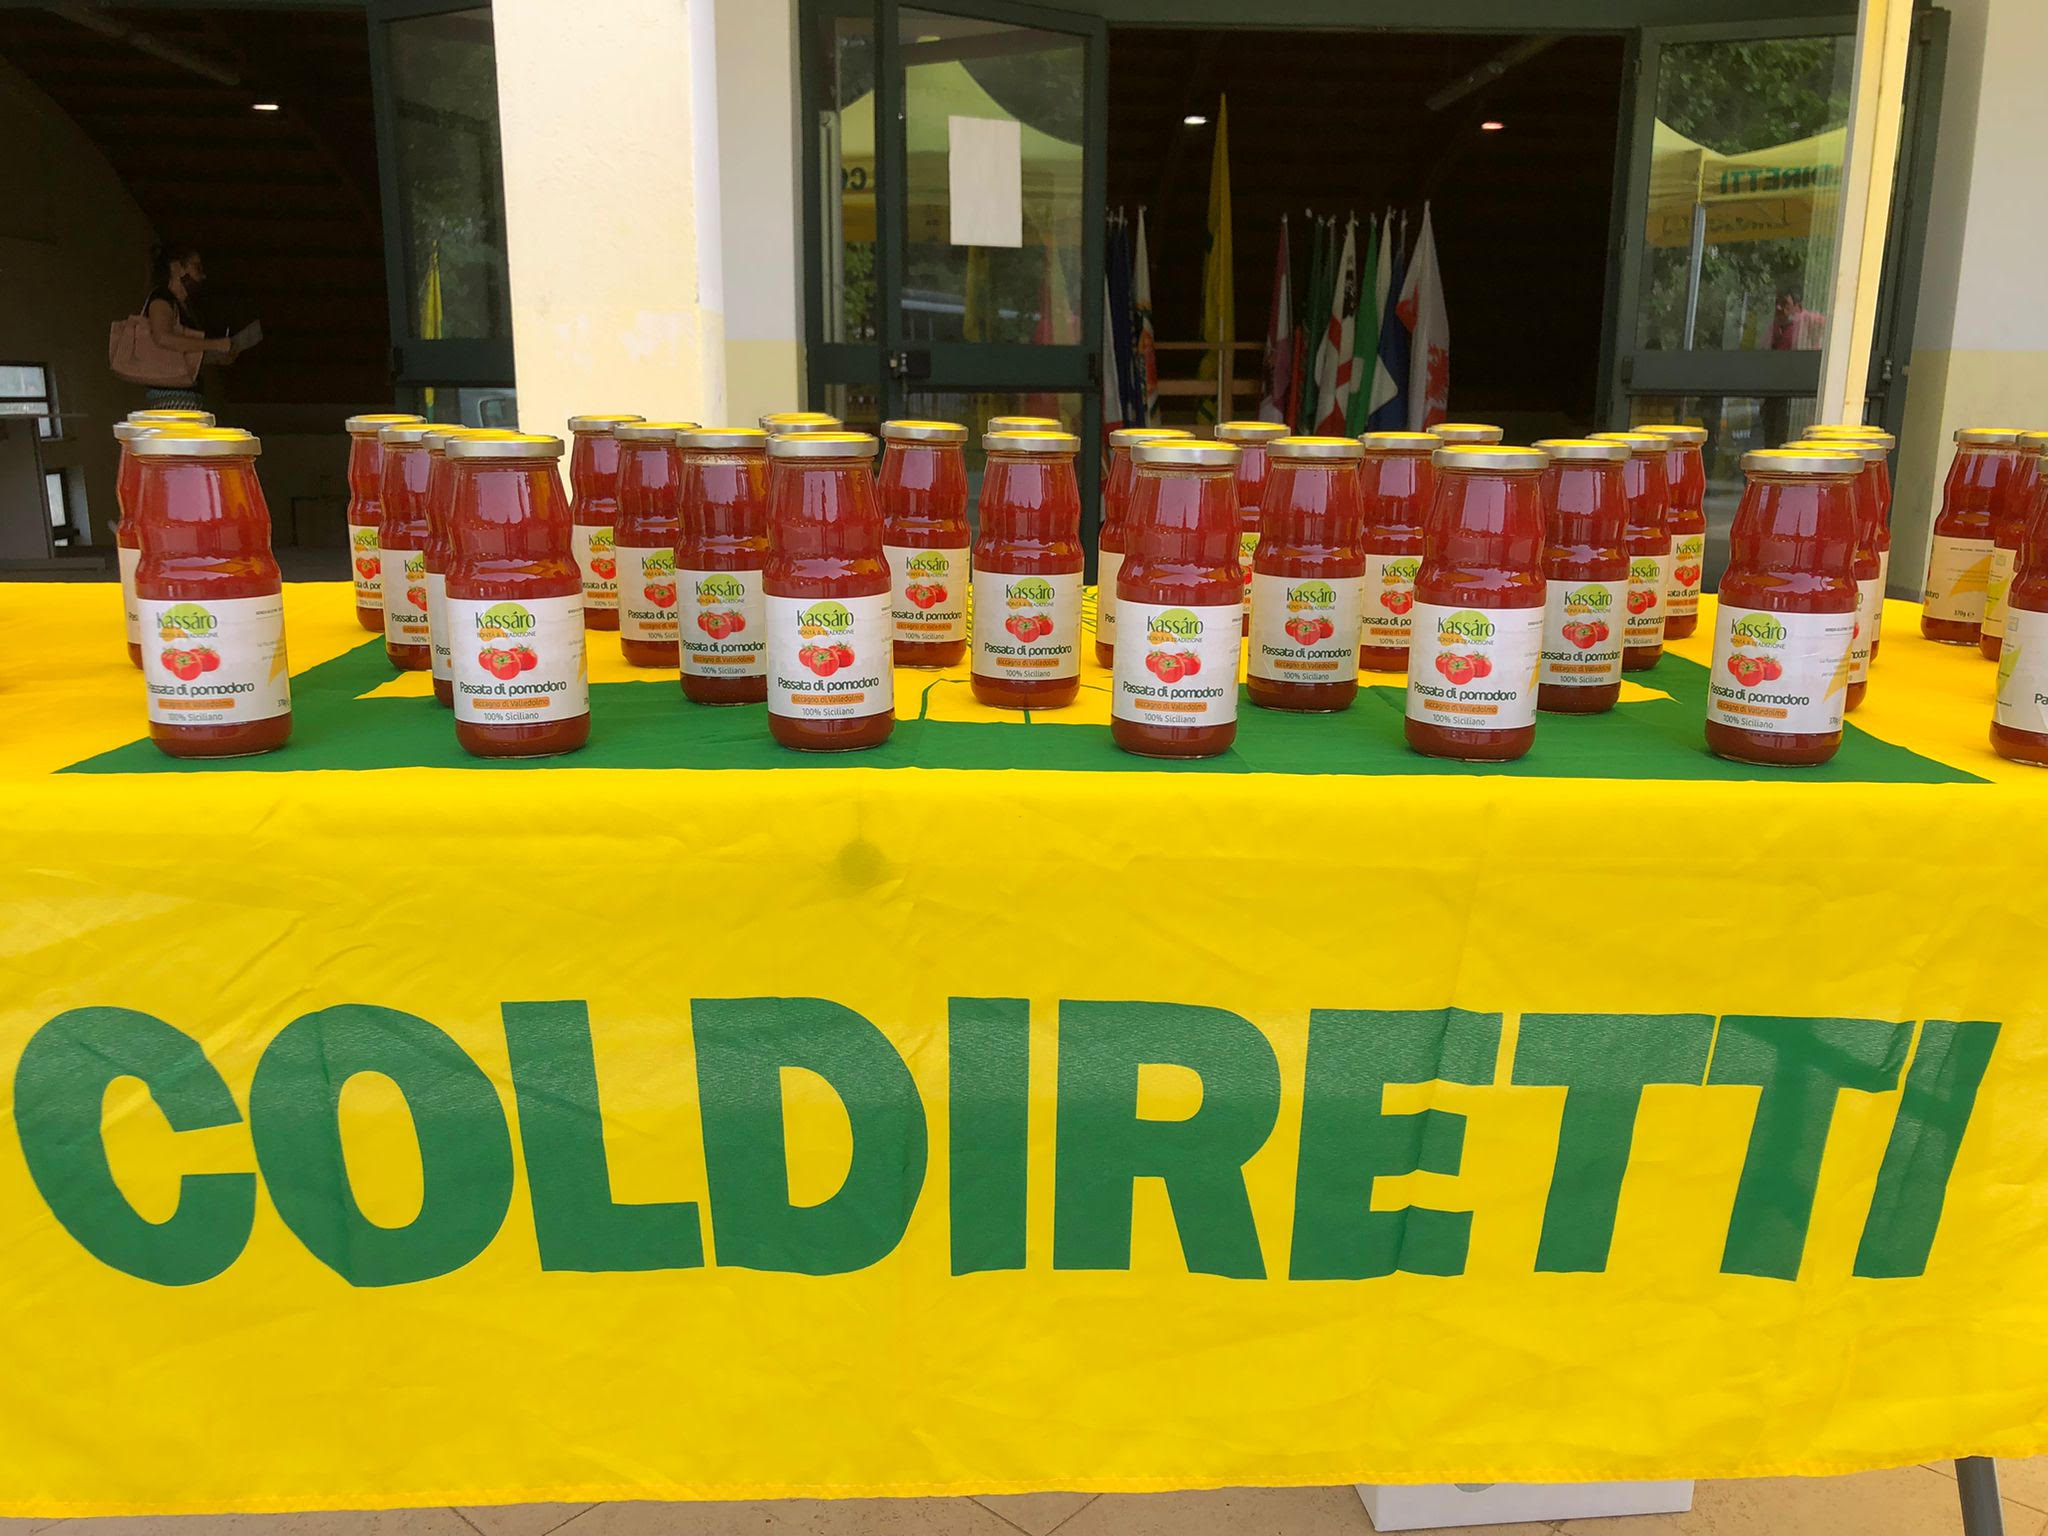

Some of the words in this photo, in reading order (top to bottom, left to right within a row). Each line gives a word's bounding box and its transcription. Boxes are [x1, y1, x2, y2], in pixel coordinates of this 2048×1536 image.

[353, 534, 378, 545] Kassár
[588, 534, 615, 545] Kass
[641, 556, 675, 570] Kassá
[906, 556, 950, 571] Kassáro
[1381, 564, 1418, 577] Kassár
[1631, 564, 1660, 577] assáro
[695, 581, 745, 597] Kassáro
[1005, 584, 1055, 600] Kassáro
[1286, 587, 1337, 603] Kassáro
[1564, 591, 1613, 606] Kassáro
[156, 611, 218, 630] Kassáro
[391, 613, 418, 623] Passata
[475, 611, 536, 629] Kassáro
[628, 609, 655, 619] Passata
[656, 610, 665, 620] di
[796, 609, 854, 627] Kassáro
[891, 611, 914, 619] ssata
[915, 611, 924, 620] di
[925, 611, 962, 621] pomodoro
[1362, 616, 1389, 625] assata
[1390, 616, 1399, 626] di
[1627, 616, 1636, 626] di
[1147, 615, 1203, 635] Kassáro
[1437, 616, 1495, 637] Kassáro
[1730, 618, 1787, 641] Kassáro
[436, 644, 450, 655] Pass
[683, 640, 708, 651] Passata
[709, 642, 719, 652] di
[721, 641, 766, 653] pomodor
[984, 642, 1015, 655] Passata
[1016, 645, 1026, 656] di
[1029, 645, 1072, 657] pomodoro
[1262, 644, 1294, 657] Passata
[1295, 648, 1305, 658] di
[1307, 648, 1352, 660] pomodoro
[1541, 651, 1571, 661] assata
[1573, 651, 1583, 661] di
[1585, 650, 1620, 663] pomodor
[718, 666, 746, 674] Siciliano
[1006, 669, 1022, 677] 100%
[1024, 669, 1051, 678] Siciliano
[1283, 671, 1300, 680] 100%
[1302, 672, 1329, 680] Siciliano
[176, 684, 188, 695] di
[191, 682, 255, 697] pomodoro
[460, 681, 493, 695] Passata
[494, 683, 505, 696] di
[509, 680, 567, 697] pomodoro
[778, 677, 811, 691] Passata
[813, 680, 825, 691] di
[827, 677, 879, 693] pomodoro
[1123, 681, 1155, 696] Passata
[1157, 686, 1168, 698] di
[1171, 687, 1223, 700] pomodoro
[1414, 681, 1444, 697] Passata
[1446, 687, 1457, 699] di
[1460, 690, 1517, 702] pomodoro
[1710, 682, 1735, 698] Passata
[1735, 687, 1745, 700] di
[1748, 693, 1810, 706] pomodoro
[188, 712, 223, 721] Siciliano
[484, 713, 503, 721] 100%
[505, 712, 539, 720] Siciliano
[801, 708, 821, 716] 100%
[823, 707, 855, 716] Siciliano
[1144, 713, 1163, 722] 100%
[1165, 714, 1196, 723] Siciliano
[1432, 714, 1451, 723] 100%
[1453, 716, 1485, 726] Siciliano
[1723, 714, 1739, 725] 100%
[1740, 716, 1774, 729] Siciliano
[13, 997, 2002, 1287] COLDIRETTI
